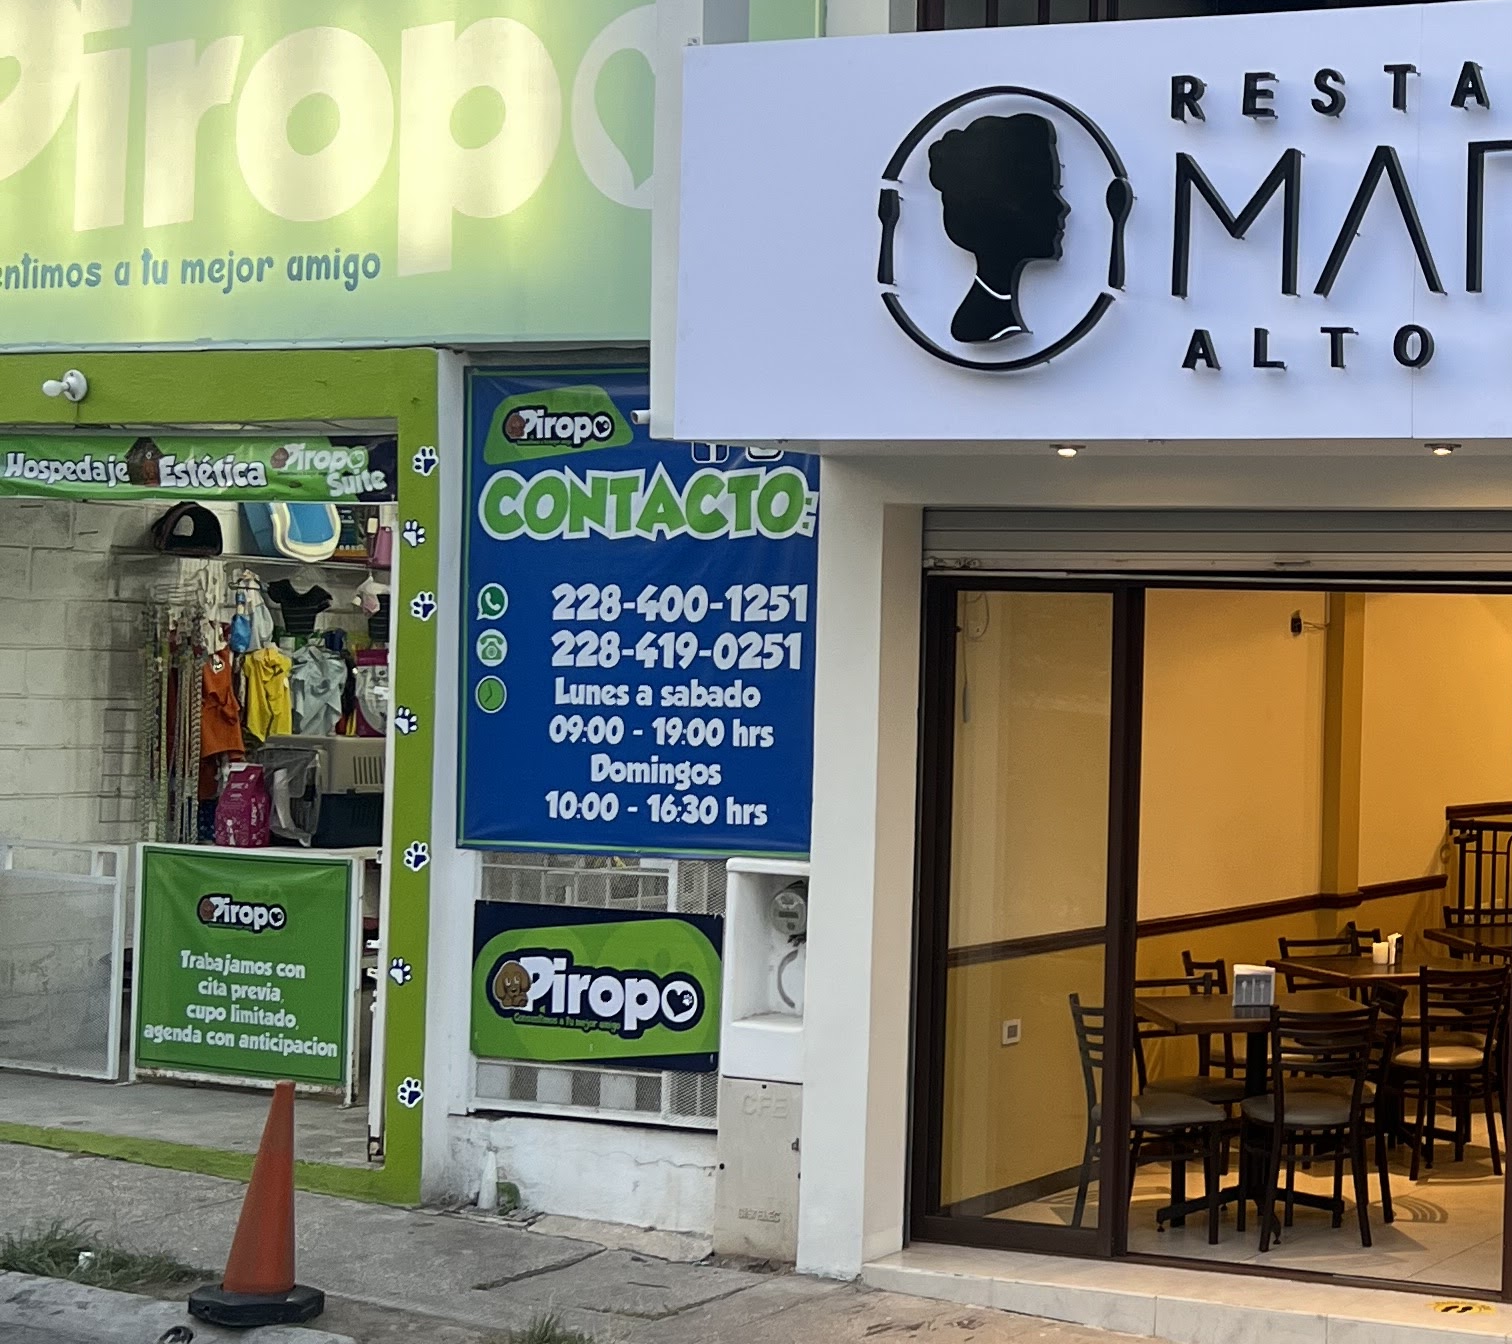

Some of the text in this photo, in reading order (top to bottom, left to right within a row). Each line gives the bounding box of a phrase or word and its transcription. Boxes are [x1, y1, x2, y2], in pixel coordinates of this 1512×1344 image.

[0, 248, 381, 294] ntimos a tu mejor amigo
[1182, 323, 1435, 370] ALTO
[519, 408, 612, 444] Piropo
[4, 452, 268, 488] Hospedaje Estética
[327, 467, 388, 498] Suite
[551, 583, 808, 623] 228-400-1251
[551, 629, 802, 671] 228-419-0251
[554, 676, 761, 708] Lunes a sabado
[549, 714, 625, 745] 09:00
[652, 716, 725, 747] 19:00
[732, 718, 774, 748] hrs
[590, 753, 722, 791] Domingos
[545, 791, 620, 821] 10:00
[646, 794, 719, 825] 16:30
[726, 797, 768, 826] hrs
[209, 896, 285, 930] Piropo
[180, 949, 306, 979] Trabajamos con
[197, 978, 227, 997] cita
[518, 955, 699, 1031] Piropo
[186, 1004, 226, 1023] cupo
[143, 1022, 338, 1058] agenda con anticipacion
